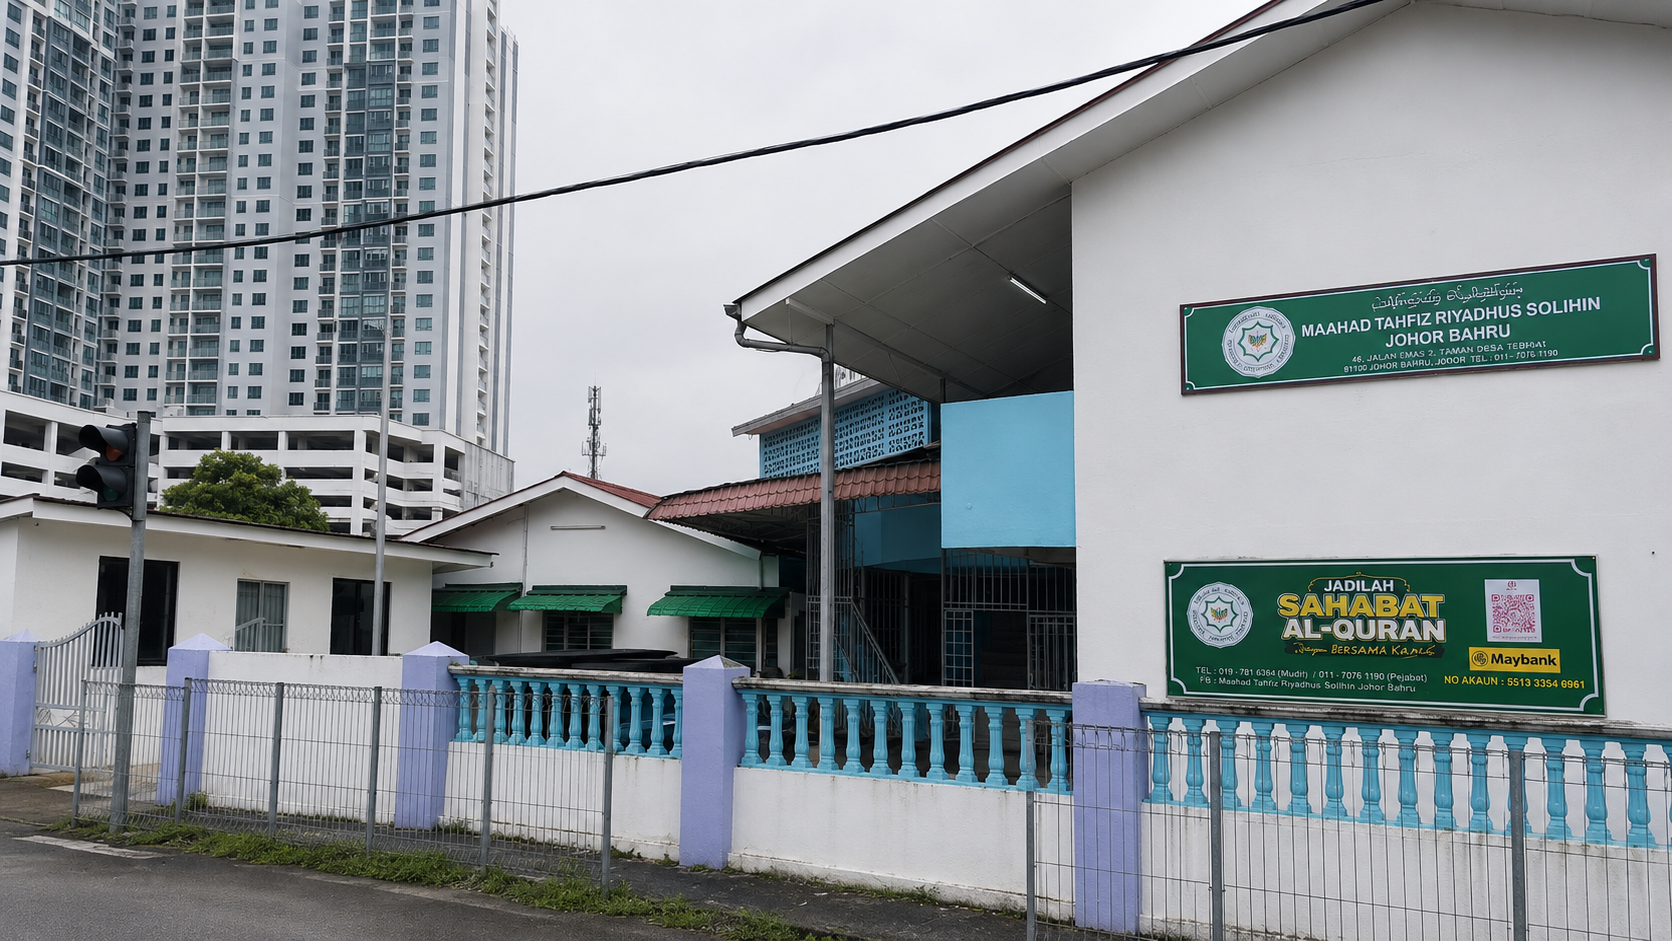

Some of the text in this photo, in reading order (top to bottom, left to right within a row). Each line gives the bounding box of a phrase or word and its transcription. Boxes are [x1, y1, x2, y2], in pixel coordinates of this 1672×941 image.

[1301, 318, 1371, 337] MAAHAD
[1374, 312, 1432, 331] TAHFIZ
[1435, 303, 1522, 325] RIYADHUS
[1526, 296, 1601, 316] SOLIHIN
[1385, 323, 1511, 348] JOHOR BAHRU
[1366, 352, 1397, 362] JALAN
[1369, 361, 1398, 371] JOHOR
[1538, 349, 1559, 358] 1190
[1324, 579, 1395, 593] JADILAH
[1278, 593, 1446, 619] SAHABAT
[1281, 618, 1447, 642] AL-QURAN
[1330, 644, 1387, 656] BERSAMA
[1490, 653, 1557, 668] Maybank
[1196, 666, 1212, 675] TEL
[1218, 667, 1233, 676] 019
[1318, 670, 1334, 679] 011
[1341, 671, 1362, 680] 7076
[1364, 672, 1385, 681] 1190
[1444, 675, 1459, 685] NO
[1461, 676, 1498, 686] AKAUN
[1357, 683, 1385, 691] Johor
